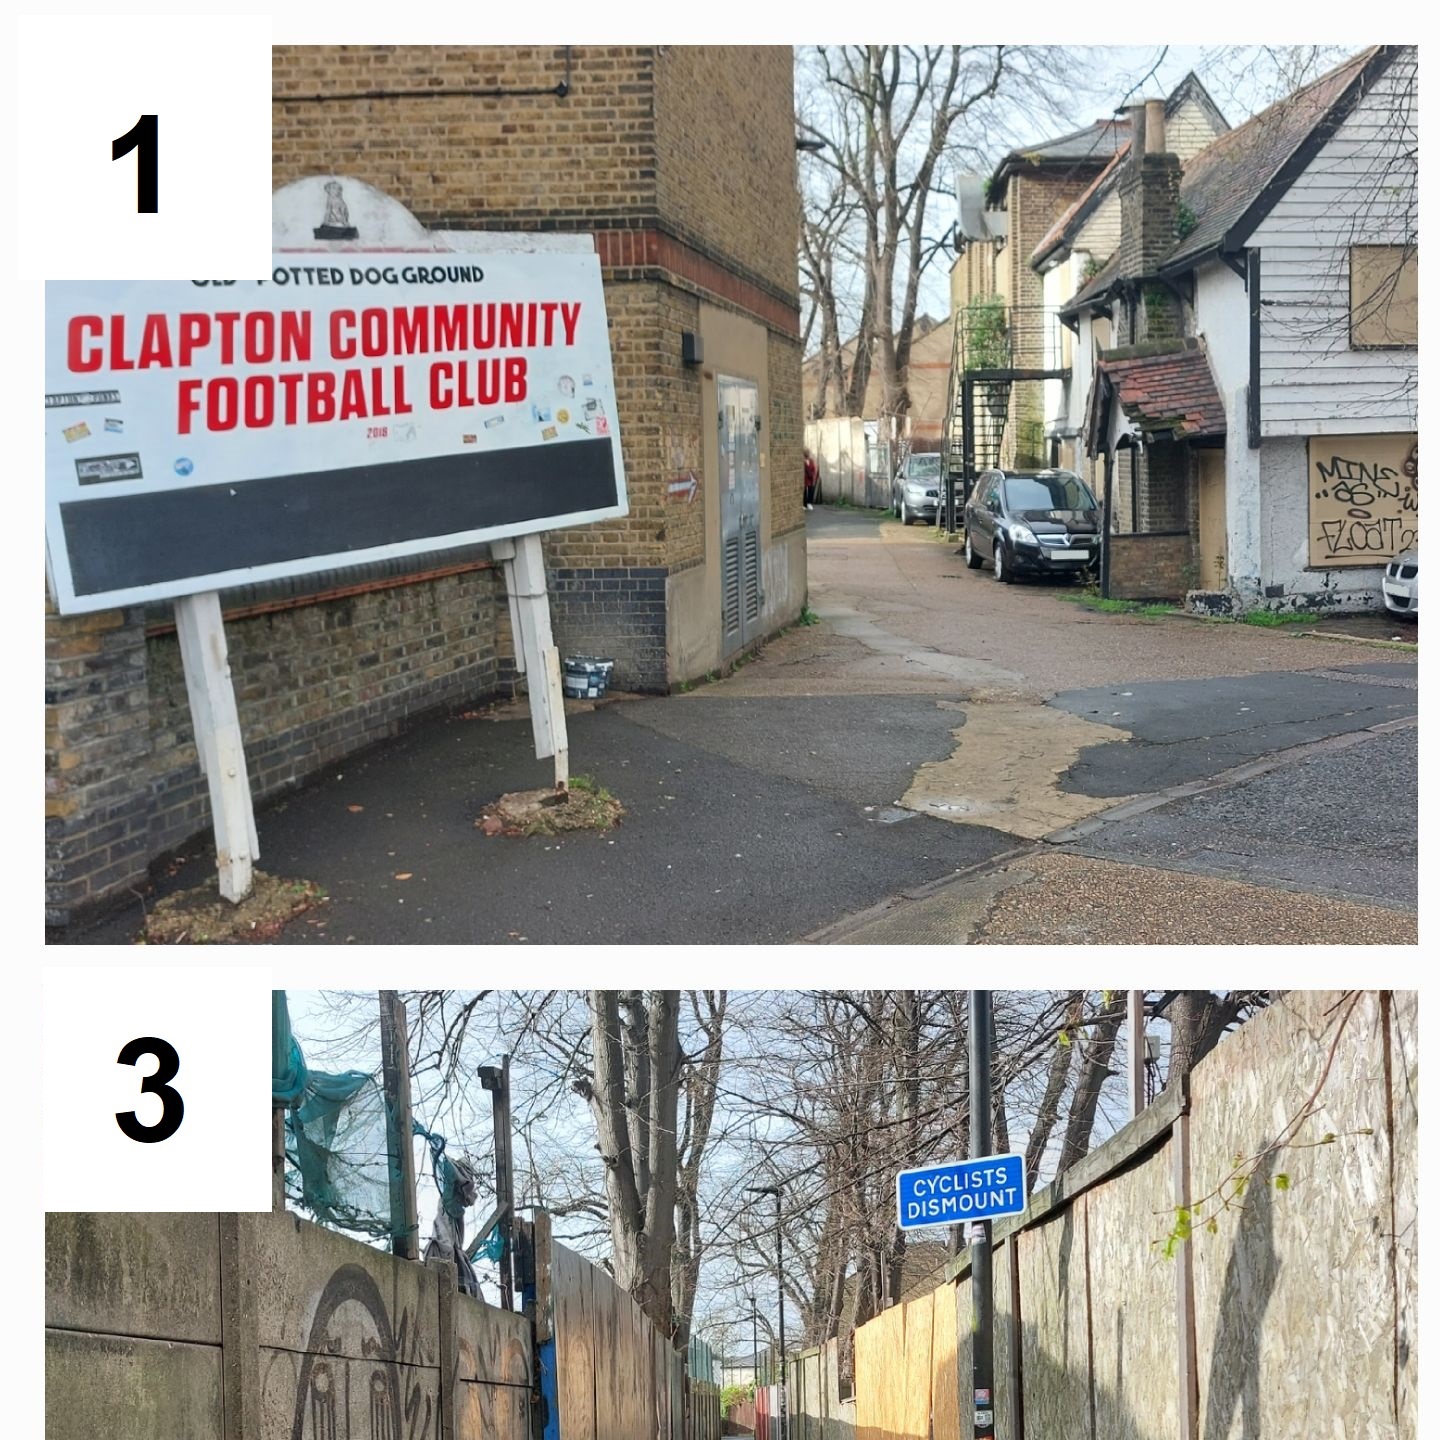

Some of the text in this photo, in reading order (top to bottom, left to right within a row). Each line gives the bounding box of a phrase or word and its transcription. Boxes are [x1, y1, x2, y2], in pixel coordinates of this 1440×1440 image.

[349, 267, 398, 285] DOG
[401, 265, 484, 284] GROUND
[66, 302, 582, 373] CLAPTON COMMUNITY
[176, 356, 528, 435] FOOTBALL CLUB
[913, 1167, 1008, 1197] CYCLISTS
[908, 1187, 1017, 1220] DISMOUNT
